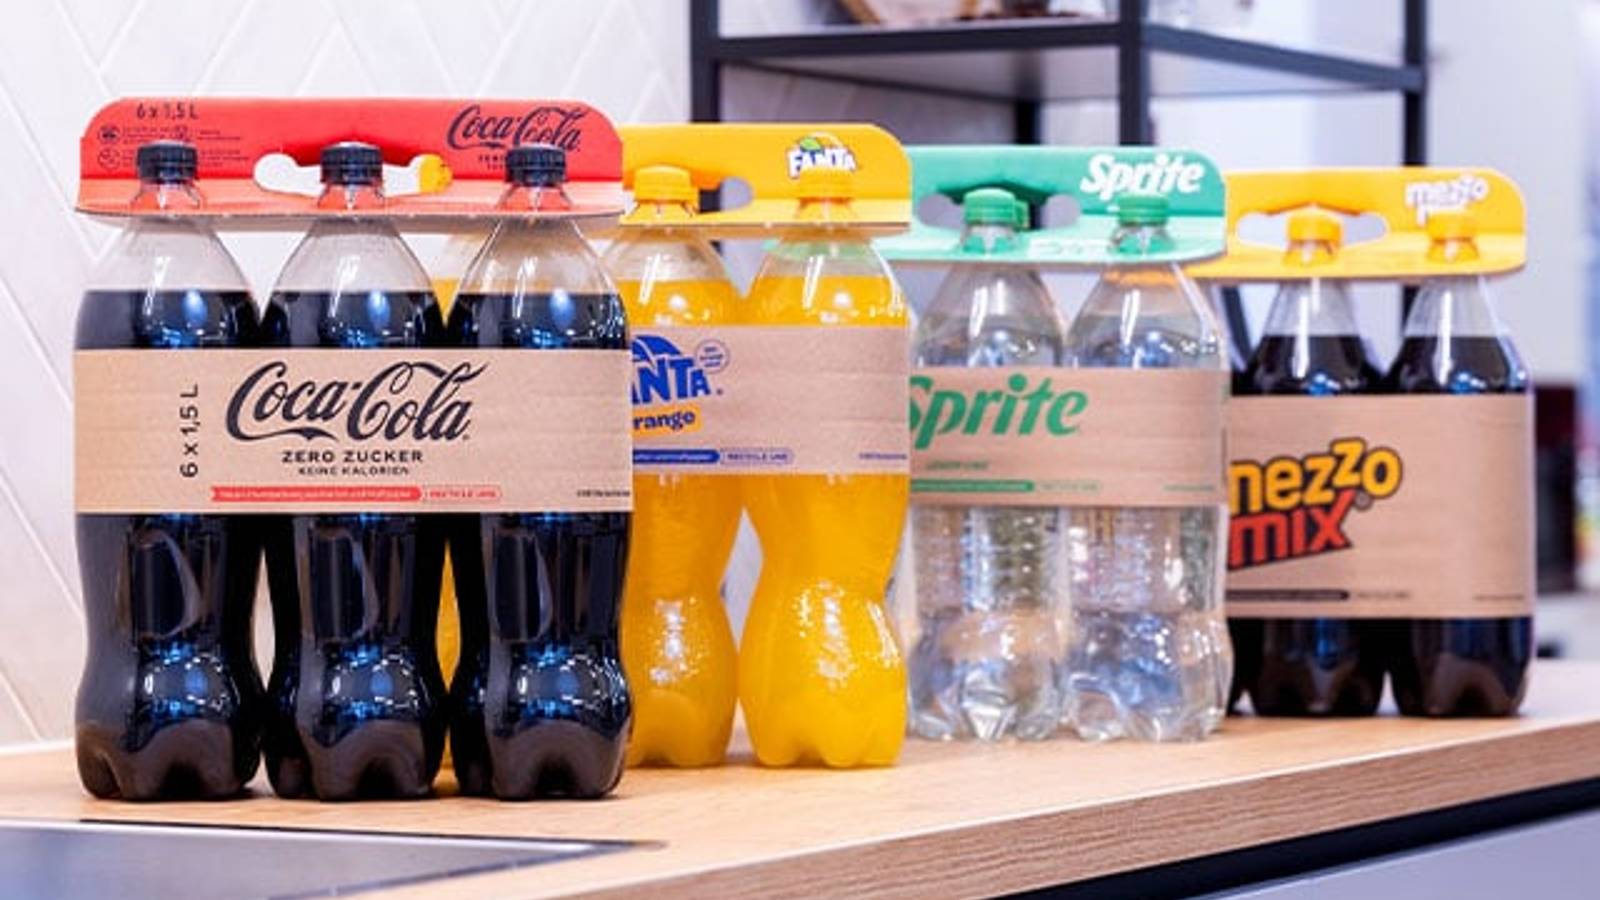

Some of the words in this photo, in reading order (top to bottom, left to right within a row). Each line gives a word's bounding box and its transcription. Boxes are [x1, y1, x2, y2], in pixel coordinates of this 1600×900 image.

[137, 103, 145, 119] 6
[149, 108, 158, 119] x
[189, 103, 198, 119] L
[447, 104, 587, 151] Coca-Cola
[1080, 153, 1205, 201] Sprite
[180, 383, 198, 397] L
[632, 358, 711, 403] NTA
[226, 361, 488, 442] Coca-Cola
[180, 405, 201, 436] 1,5
[633, 411, 696, 431] range
[184, 443, 199, 456] x
[282, 450, 335, 463] ZERO
[344, 450, 424, 463] ZUCKER
[180, 462, 199, 477] 6
[298, 467, 337, 475] KEINE
[342, 467, 410, 475] KALORIEN
[1227, 489, 1354, 572] mix
